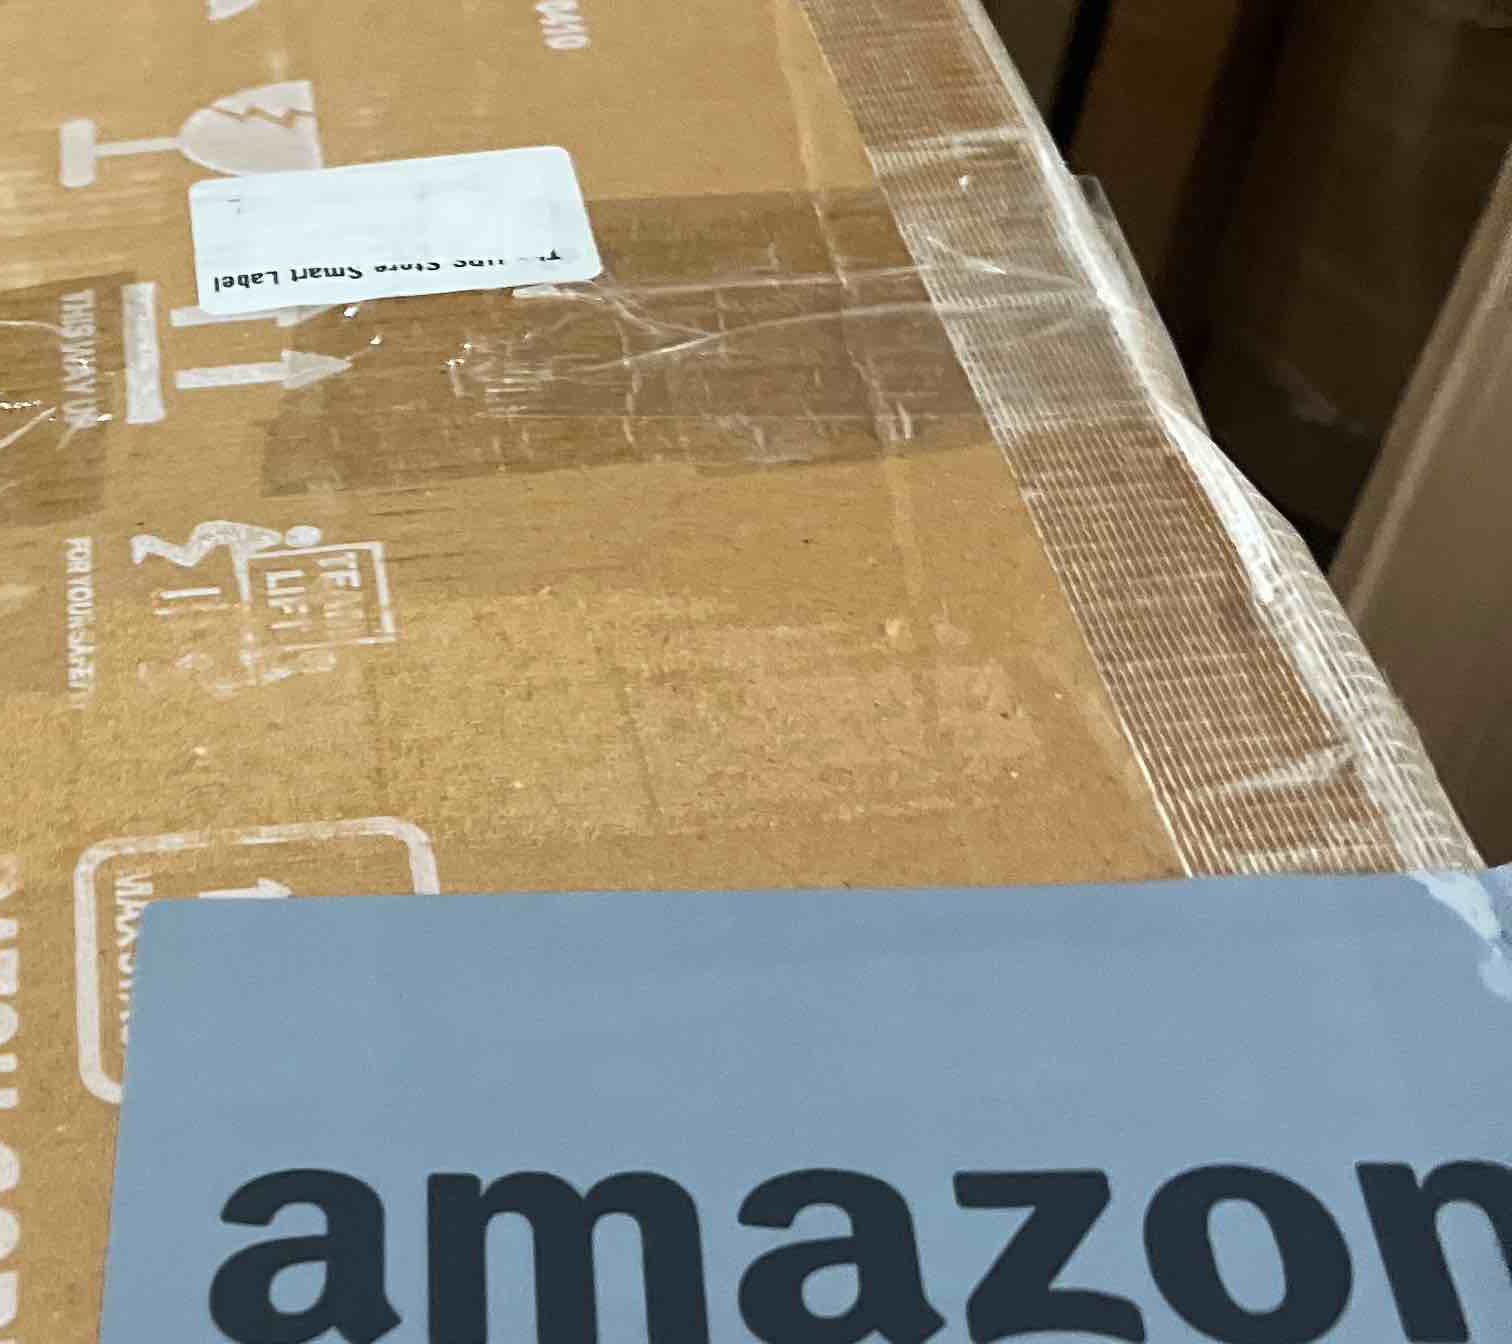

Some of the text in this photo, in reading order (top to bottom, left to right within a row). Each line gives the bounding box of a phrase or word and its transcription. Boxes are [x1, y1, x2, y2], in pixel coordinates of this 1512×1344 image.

[214, 270, 279, 293] Label
[290, 265, 363, 282] Smart
[60, 289, 96, 338] THIS
[61, 340, 96, 394] WAY
[65, 536, 93, 575] FOR
